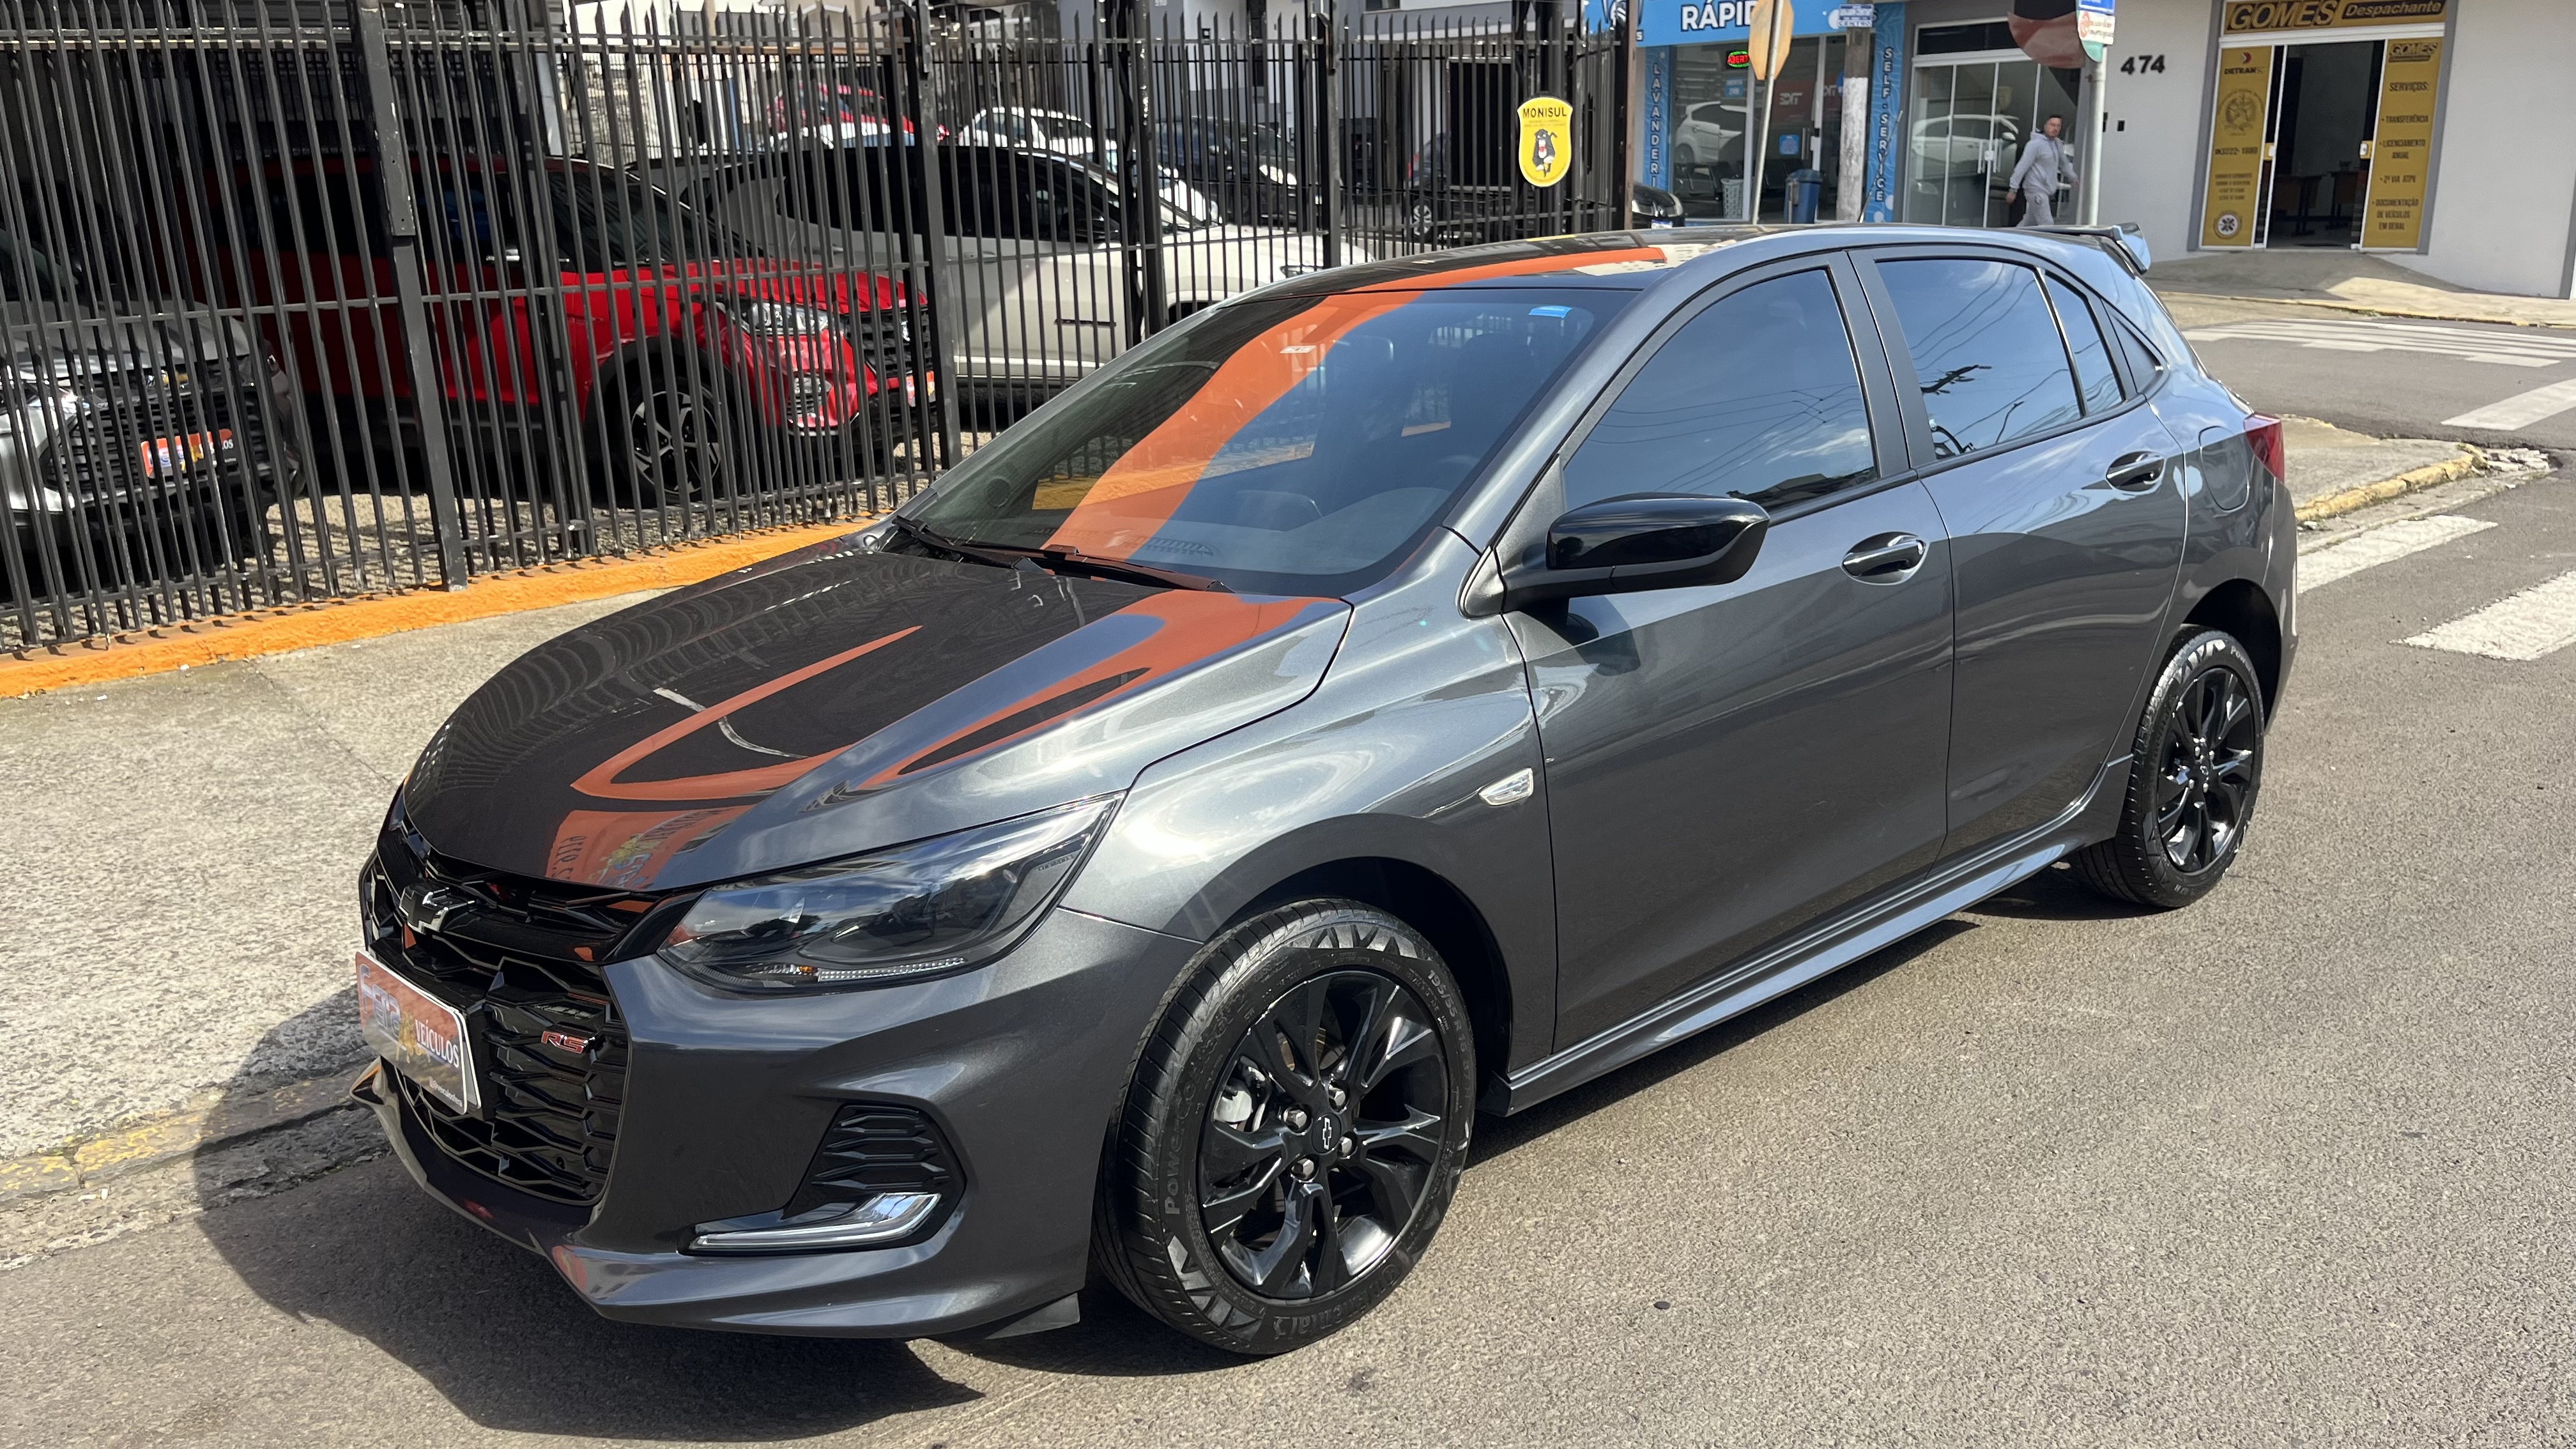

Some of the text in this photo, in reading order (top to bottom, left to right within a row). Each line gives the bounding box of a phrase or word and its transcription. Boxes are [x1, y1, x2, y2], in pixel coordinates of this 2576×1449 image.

[1681, 0, 1756, 31] RÁPID
[2228, 0, 2441, 30] GOMES Despachante
[1728, 55, 1749, 64] ABERT
[2120, 54, 2165, 75] 474
[1522, 107, 1567, 118] MONISUL
[1650, 63, 1661, 188] LAVANDERI
[414, 1018, 460, 1069] VEÍCULOS
[541, 1031, 588, 1054] RS
